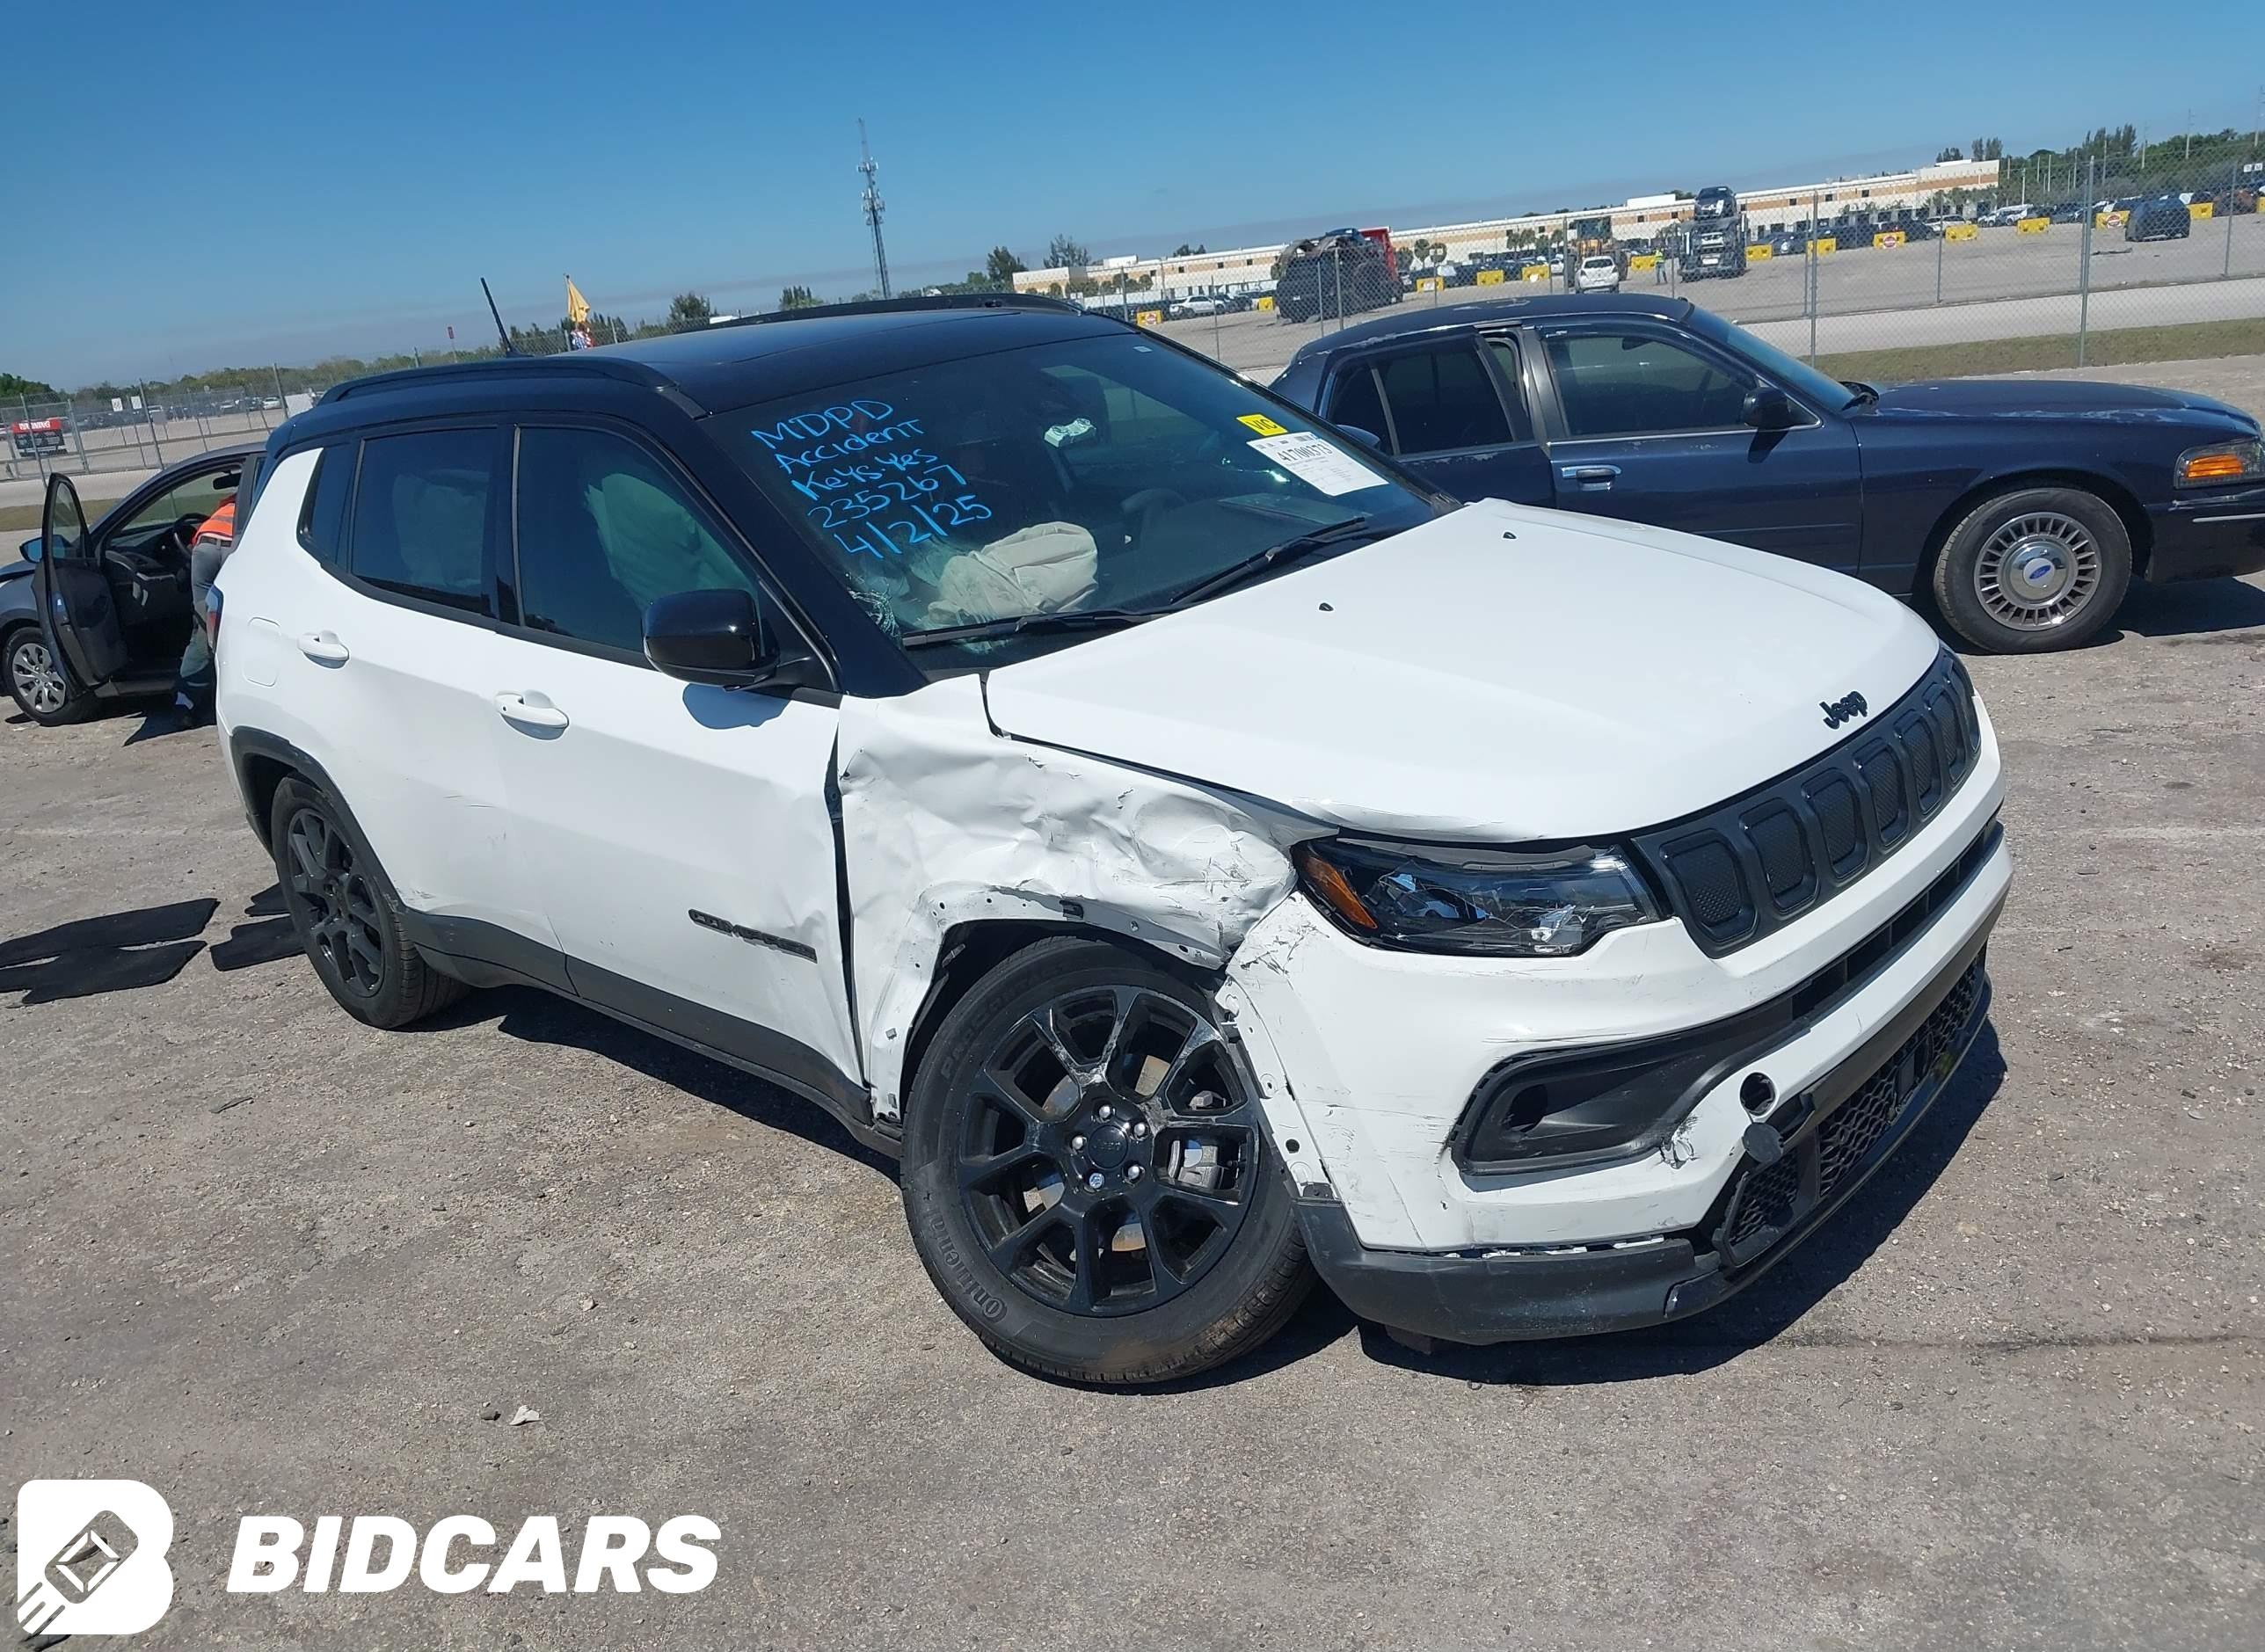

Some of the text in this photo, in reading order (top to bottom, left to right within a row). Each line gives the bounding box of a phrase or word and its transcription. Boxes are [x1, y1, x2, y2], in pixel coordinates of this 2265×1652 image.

[750, 400, 893, 449] MDPD
[807, 464, 966, 528] 235267
[834, 495, 992, 559] 4/2/25
[1818, 690, 1868, 730] Jeep
